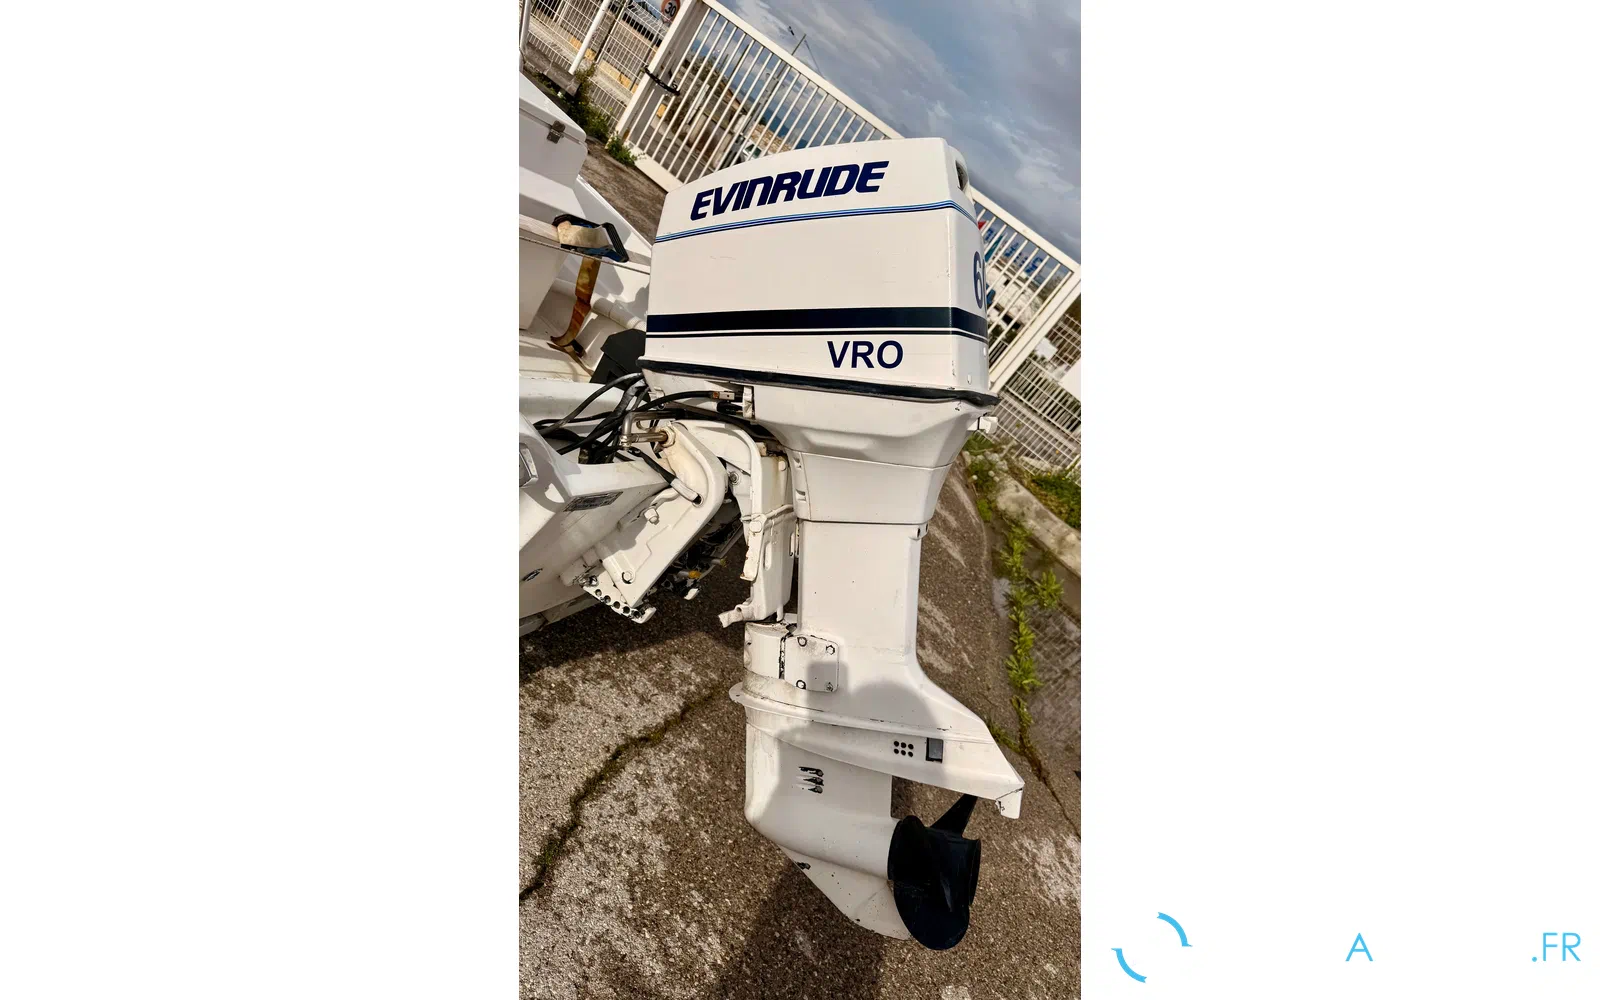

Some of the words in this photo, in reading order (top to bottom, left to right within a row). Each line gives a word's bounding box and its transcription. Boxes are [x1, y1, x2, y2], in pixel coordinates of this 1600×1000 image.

[664, 2, 676, 17] 30
[690, 161, 889, 221] EVINRUDE
[973, 251, 986, 310] 6
[827, 340, 904, 369] VRO
